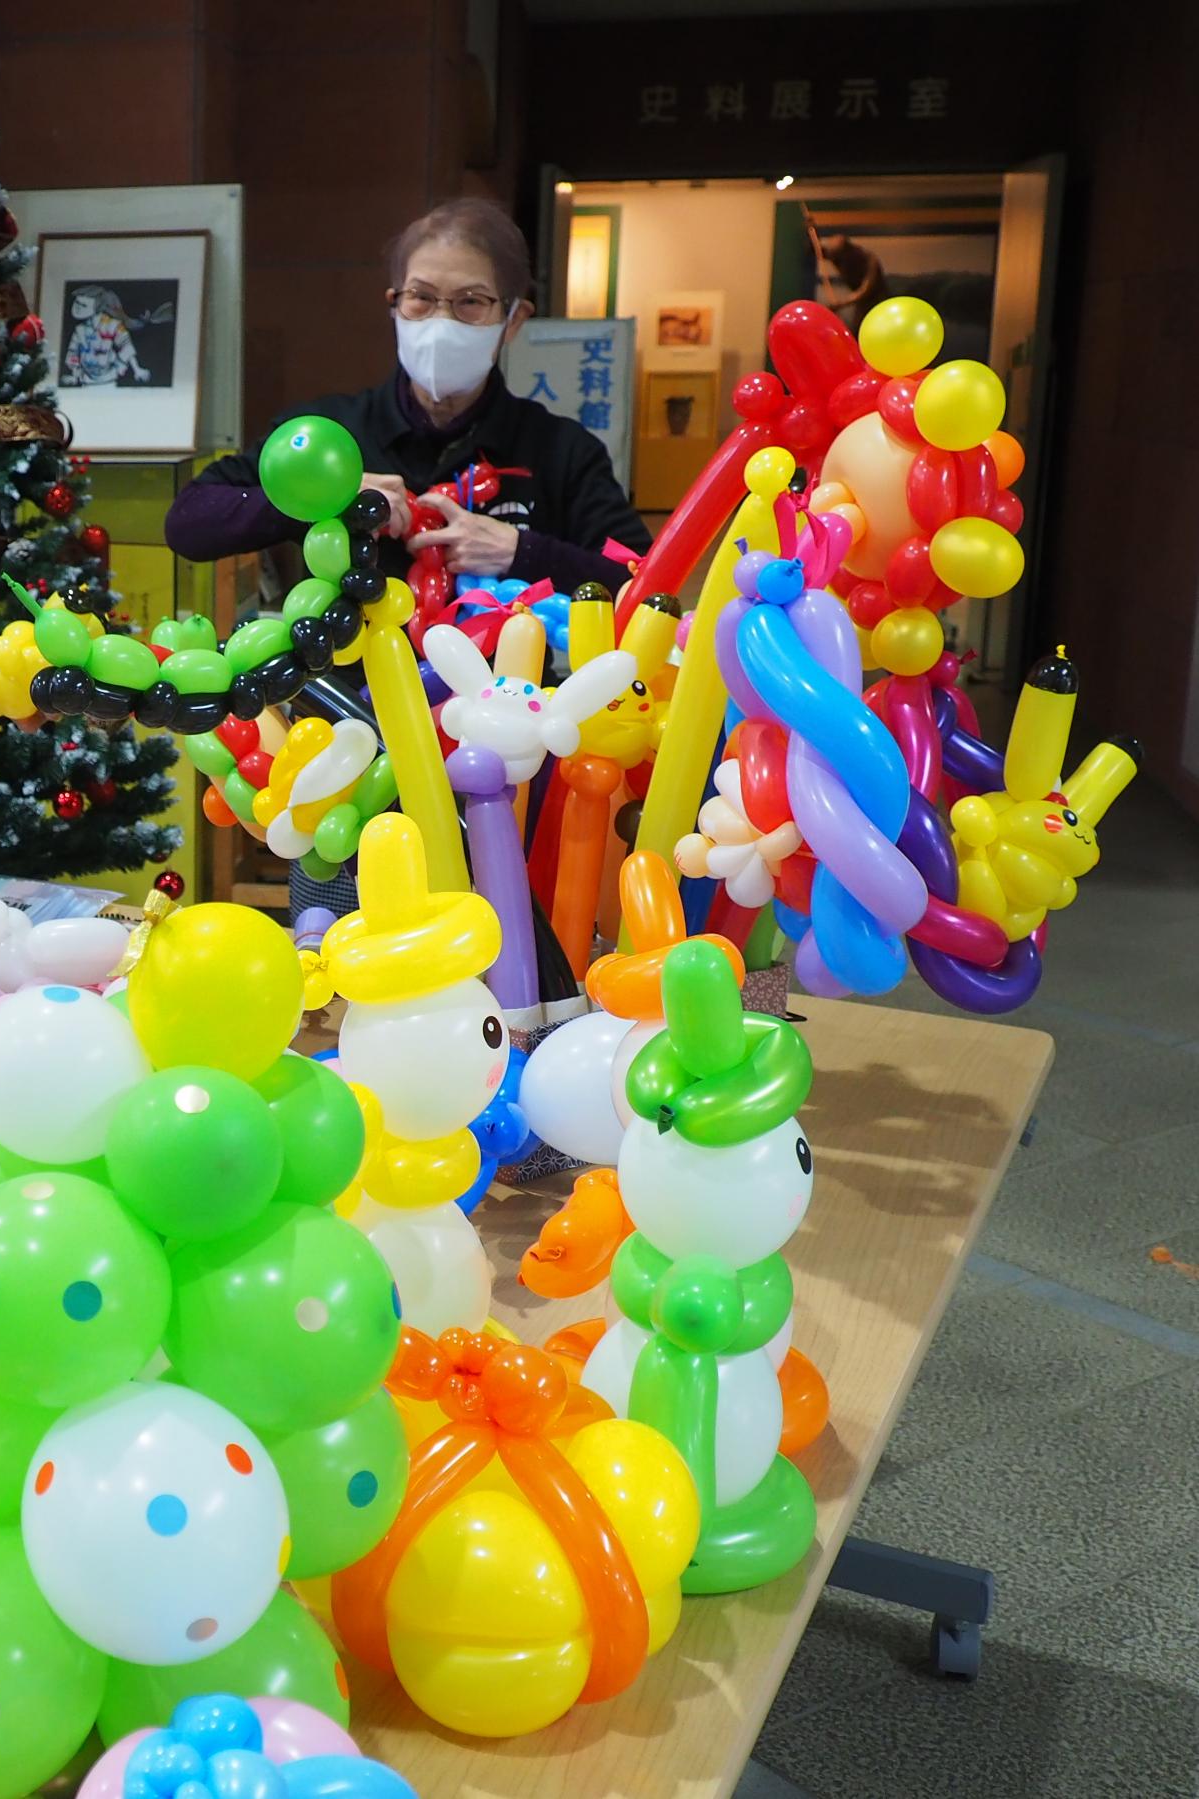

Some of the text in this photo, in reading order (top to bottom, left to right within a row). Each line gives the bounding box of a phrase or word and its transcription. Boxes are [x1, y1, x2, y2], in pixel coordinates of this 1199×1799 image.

[639, 75, 950, 124] 史料展示室
[529, 371, 557, 400] 入
[578, 337, 613, 430] 史料館
